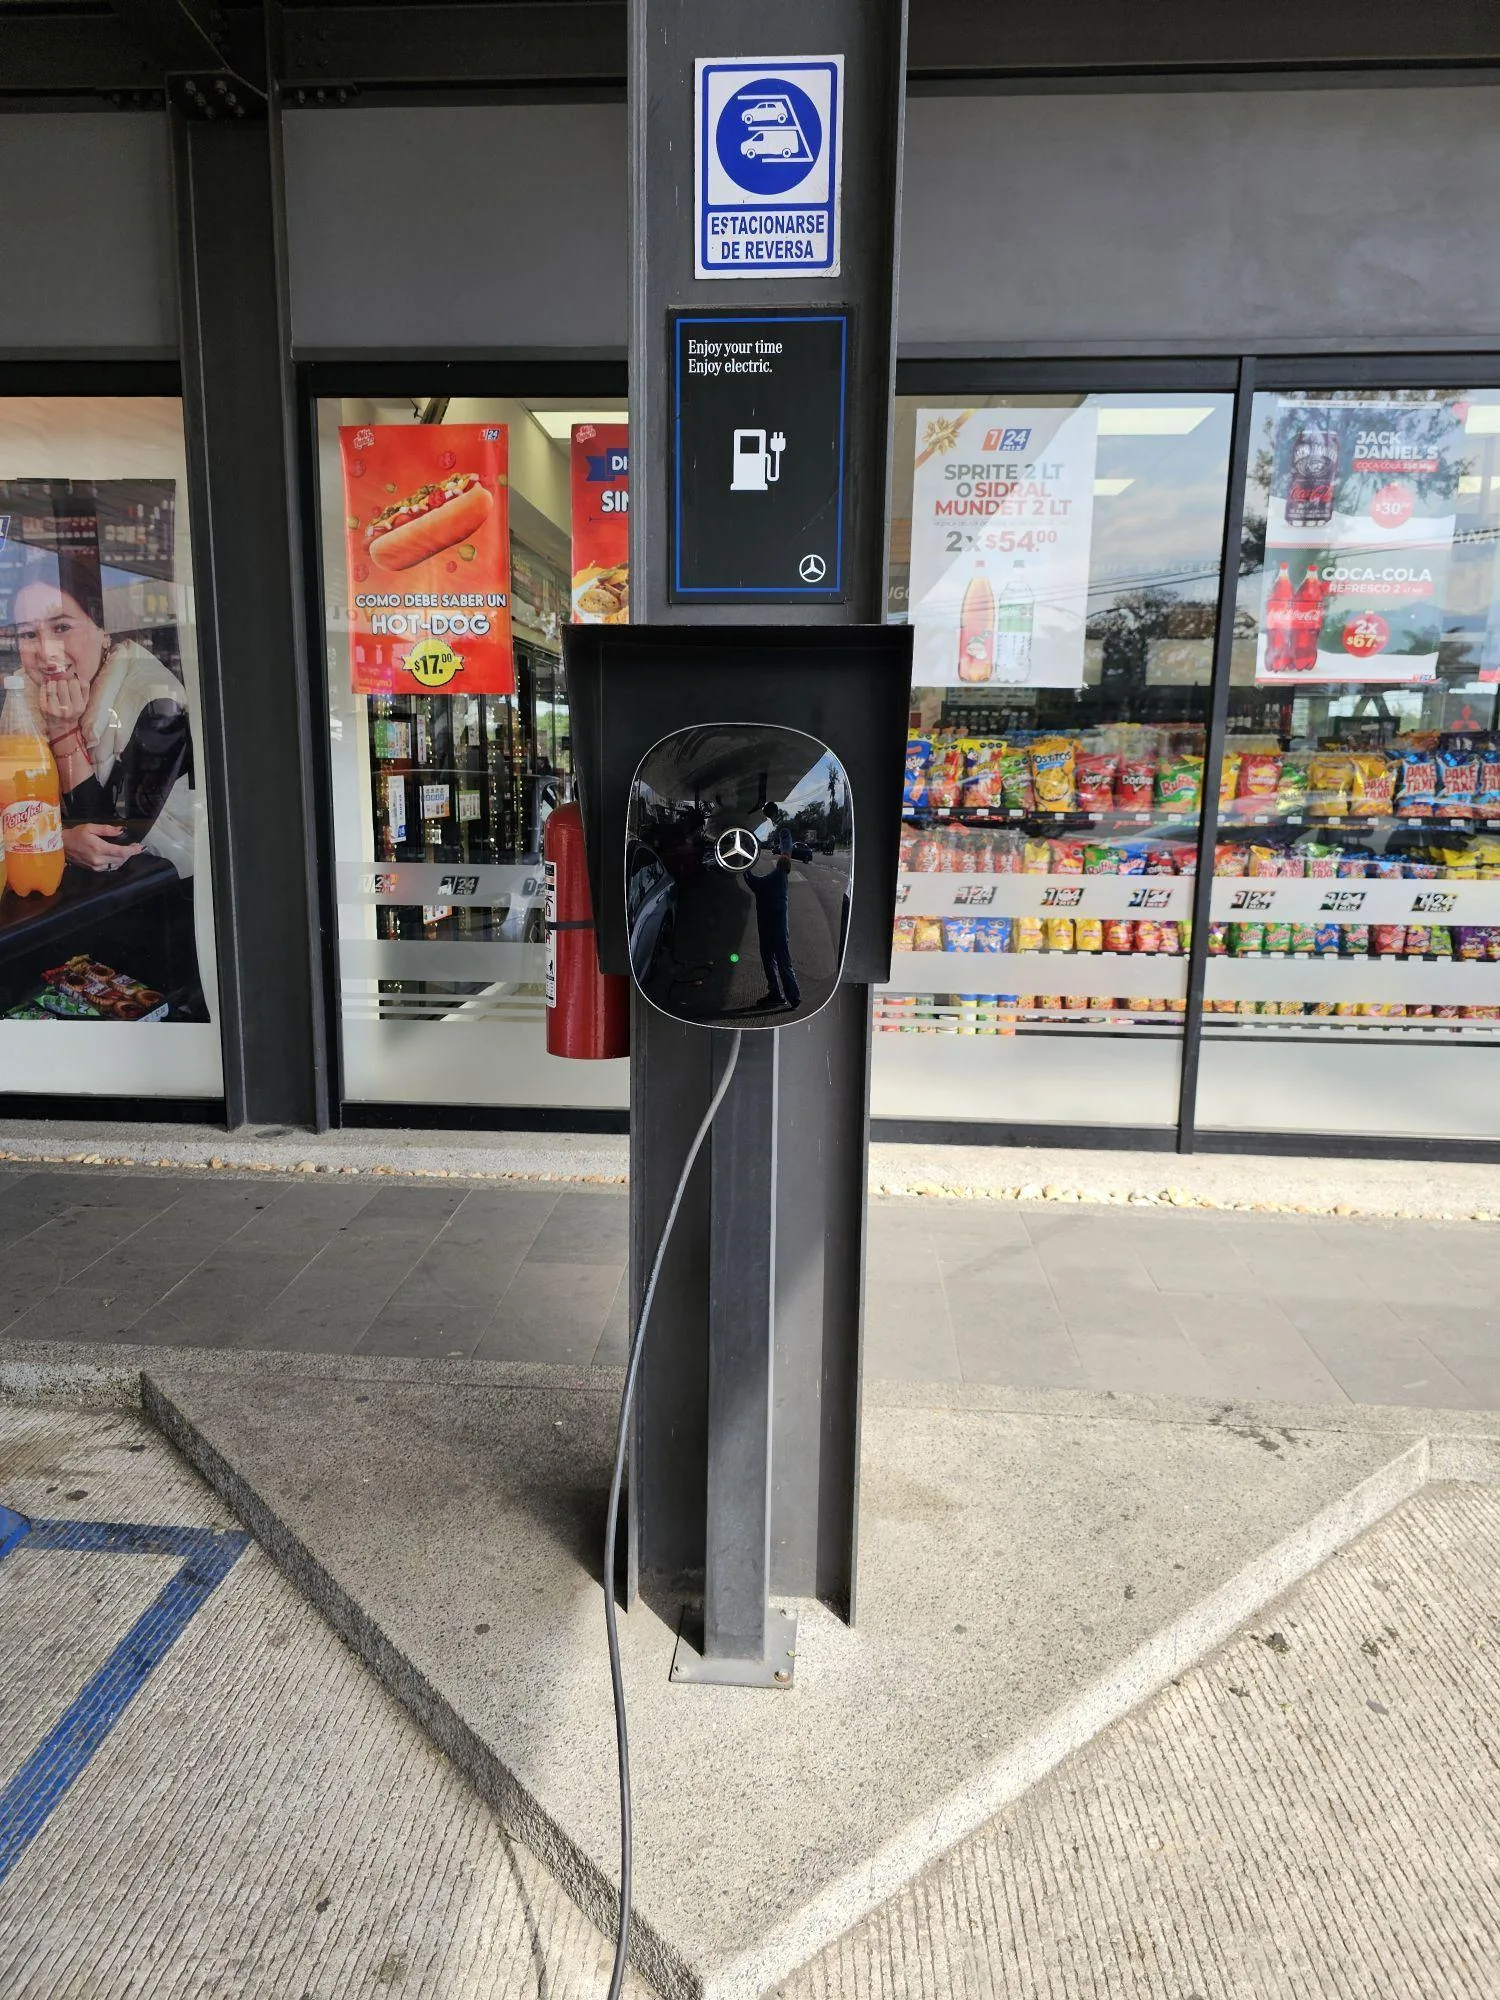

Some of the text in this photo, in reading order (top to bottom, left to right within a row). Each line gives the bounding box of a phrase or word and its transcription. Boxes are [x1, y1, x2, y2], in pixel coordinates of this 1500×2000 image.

[711, 214, 825, 235] ESTACIONARSE
[721, 240, 814, 260] DE REVERSA
[688, 339, 783, 357] Enjoy your time
[688, 358, 773, 375] Enjoy electric.
[1356, 431, 1402, 445] JACK
[1354, 445, 1439, 459] DANIEL'S
[944, 463, 1064, 480] SPRITE 2 LT
[956, 482, 1051, 498] O SIDRAL
[935, 500, 1072, 516] MUNDET 2 LT
[1321, 567, 1432, 582] COCA-COLA
[1329, 583, 1389, 594] REFRESCO
[1390, 583, 1401, 593] 2
[355, 594, 507, 608] COMO DEBE SABER UN
[371, 613, 491, 636] HOT-DOG
